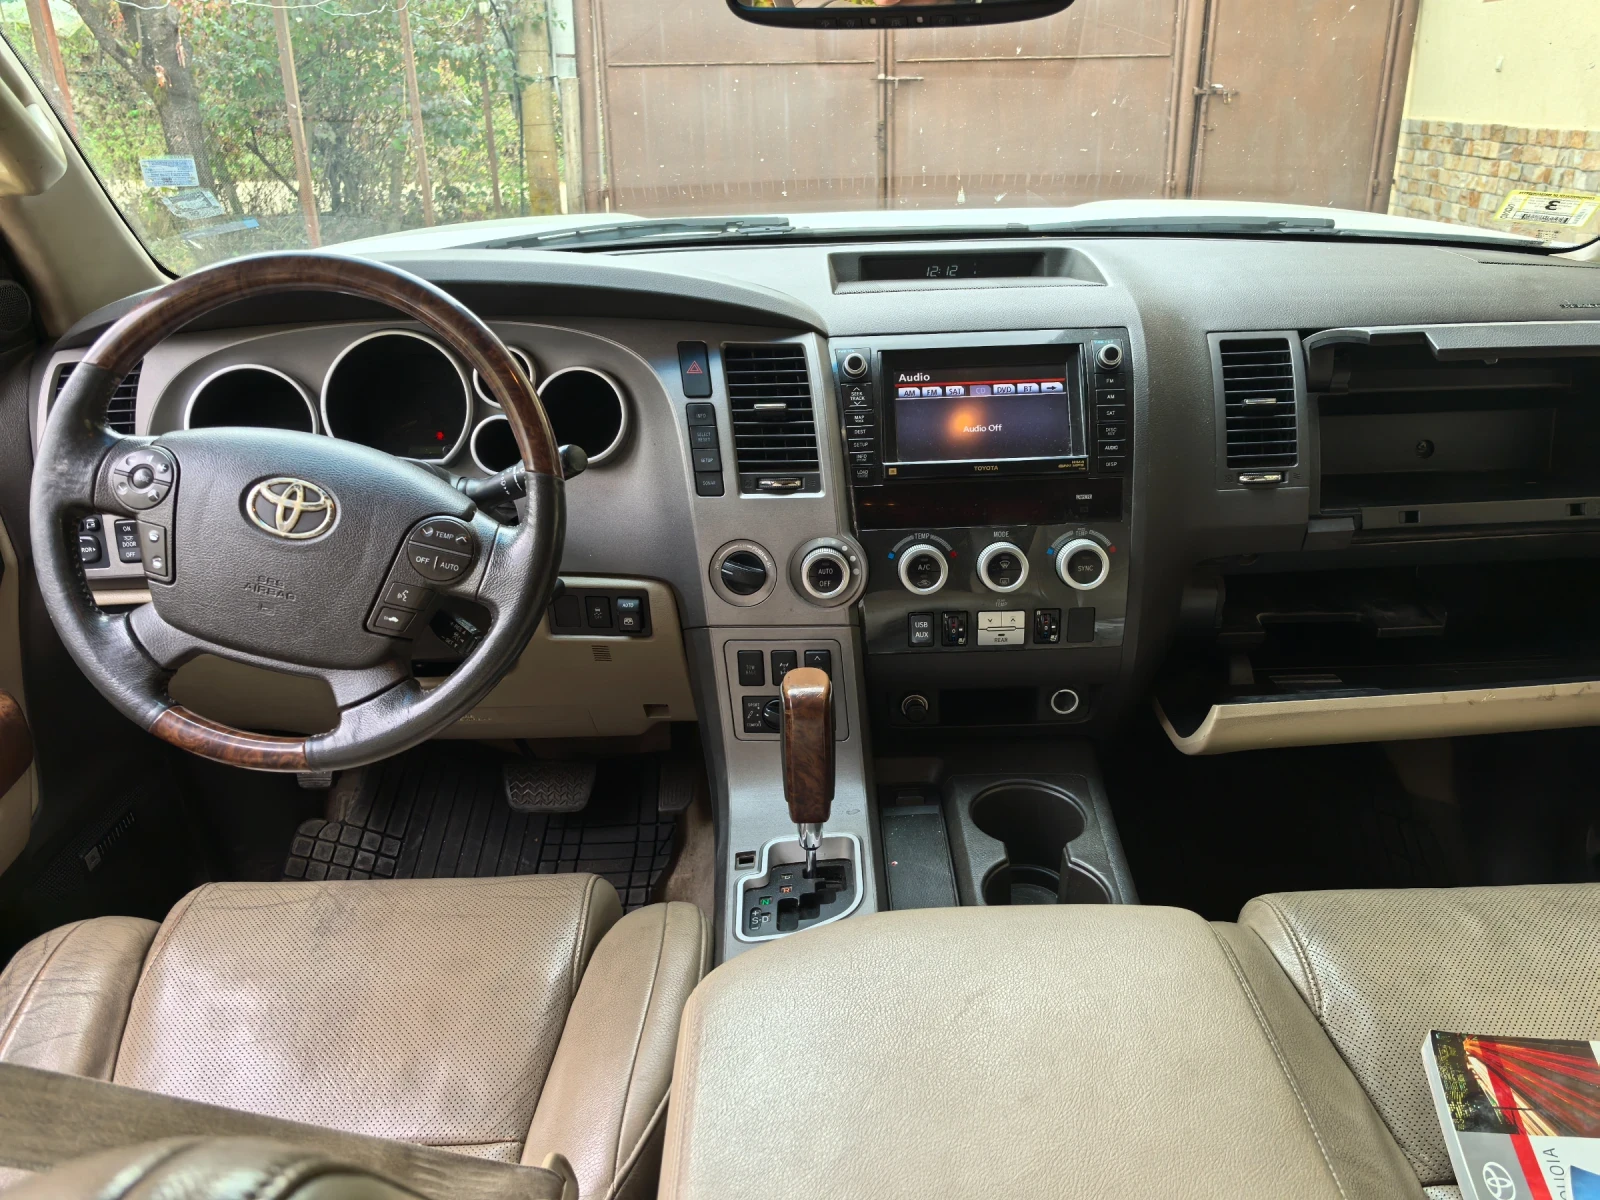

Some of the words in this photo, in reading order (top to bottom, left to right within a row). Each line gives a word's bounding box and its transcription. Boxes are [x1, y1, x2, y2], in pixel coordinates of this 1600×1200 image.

[926, 264, 958, 277] 12:12
[898, 372, 931, 382] Audio
[903, 389, 916, 397] AM
[975, 387, 986, 395] CD
[996, 386, 1012, 394] DVD
[1023, 385, 1033, 393] BT
[963, 424, 985, 433] Audio
[986, 423, 1003, 432] Off
[435, 530, 455, 540] TEMP
[914, 532, 930, 540] TEMP
[993, 530, 1010, 538] MODE
[415, 555, 430, 565] OFF
[439, 561, 460, 572] AUTO
[917, 563, 931, 571] A/C
[1077, 564, 1094, 572] SYNC
[243, 582, 296, 601] AIRBAG
[752, 917, 759, 925] S
